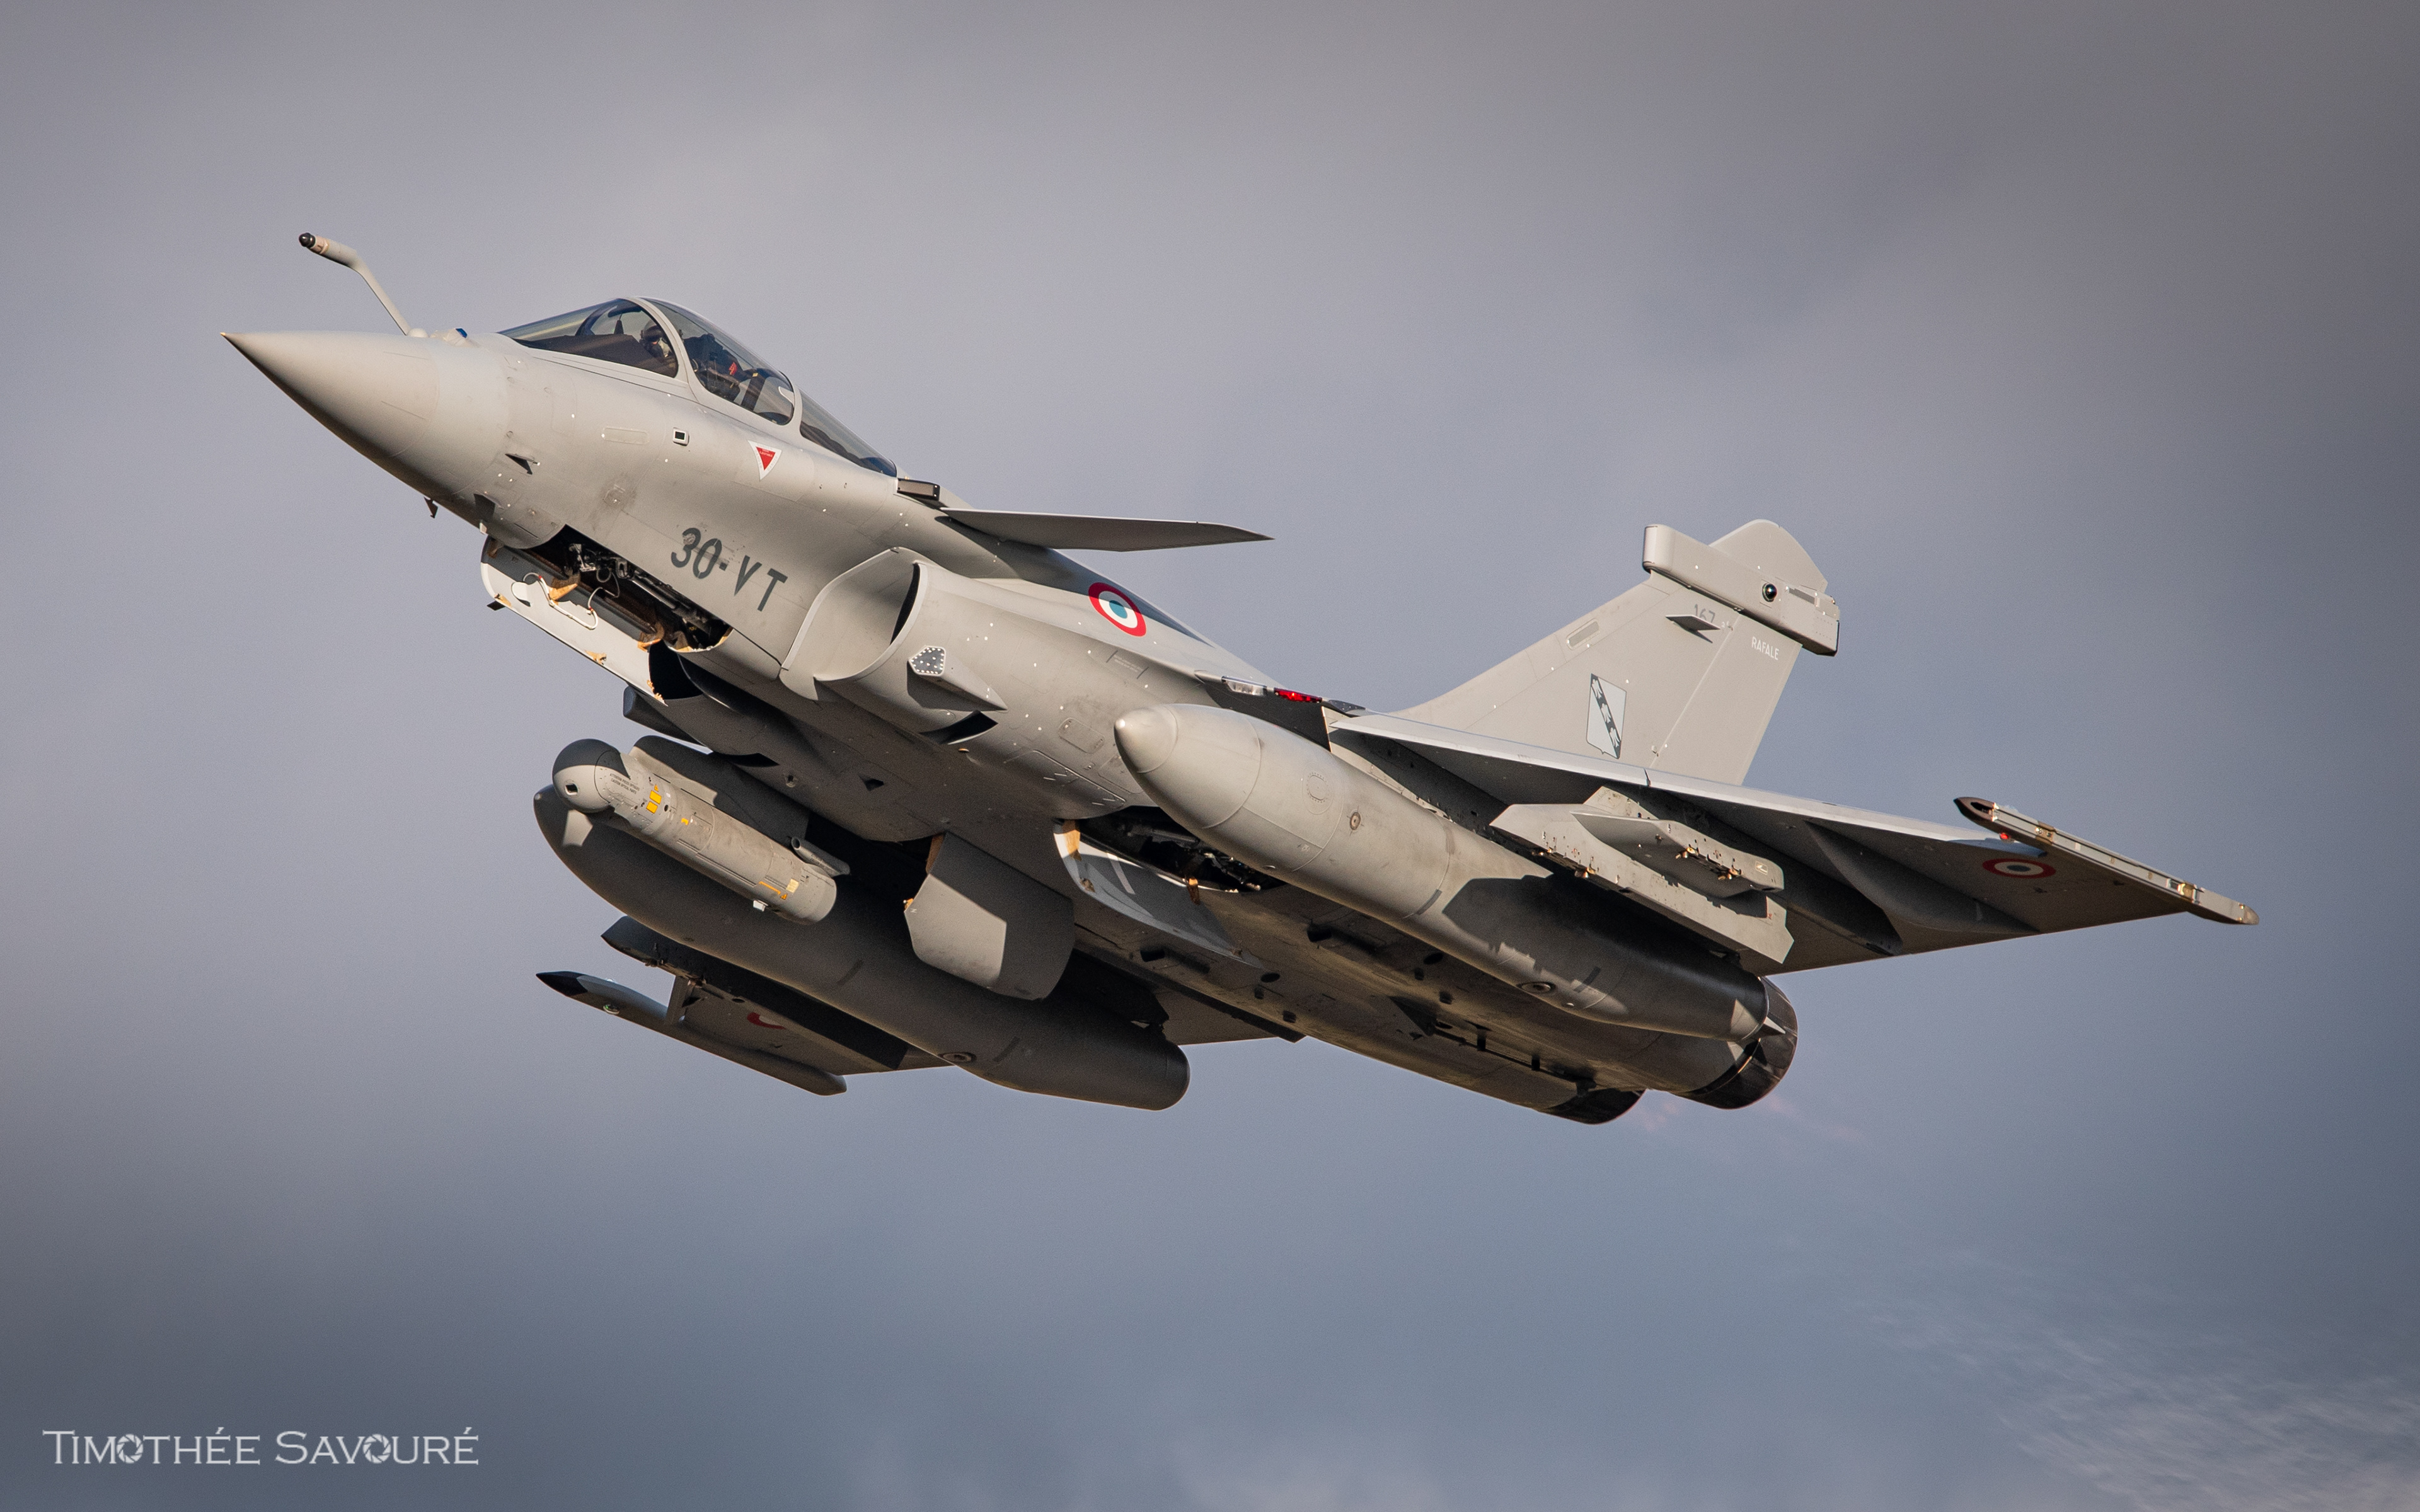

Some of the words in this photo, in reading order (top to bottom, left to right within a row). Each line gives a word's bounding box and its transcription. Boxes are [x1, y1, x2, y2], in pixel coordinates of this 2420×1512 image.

[671, 527, 788, 611] 30-VT
[1694, 604, 1715, 623] 167
[1751, 636, 1779, 660] RAFALE
